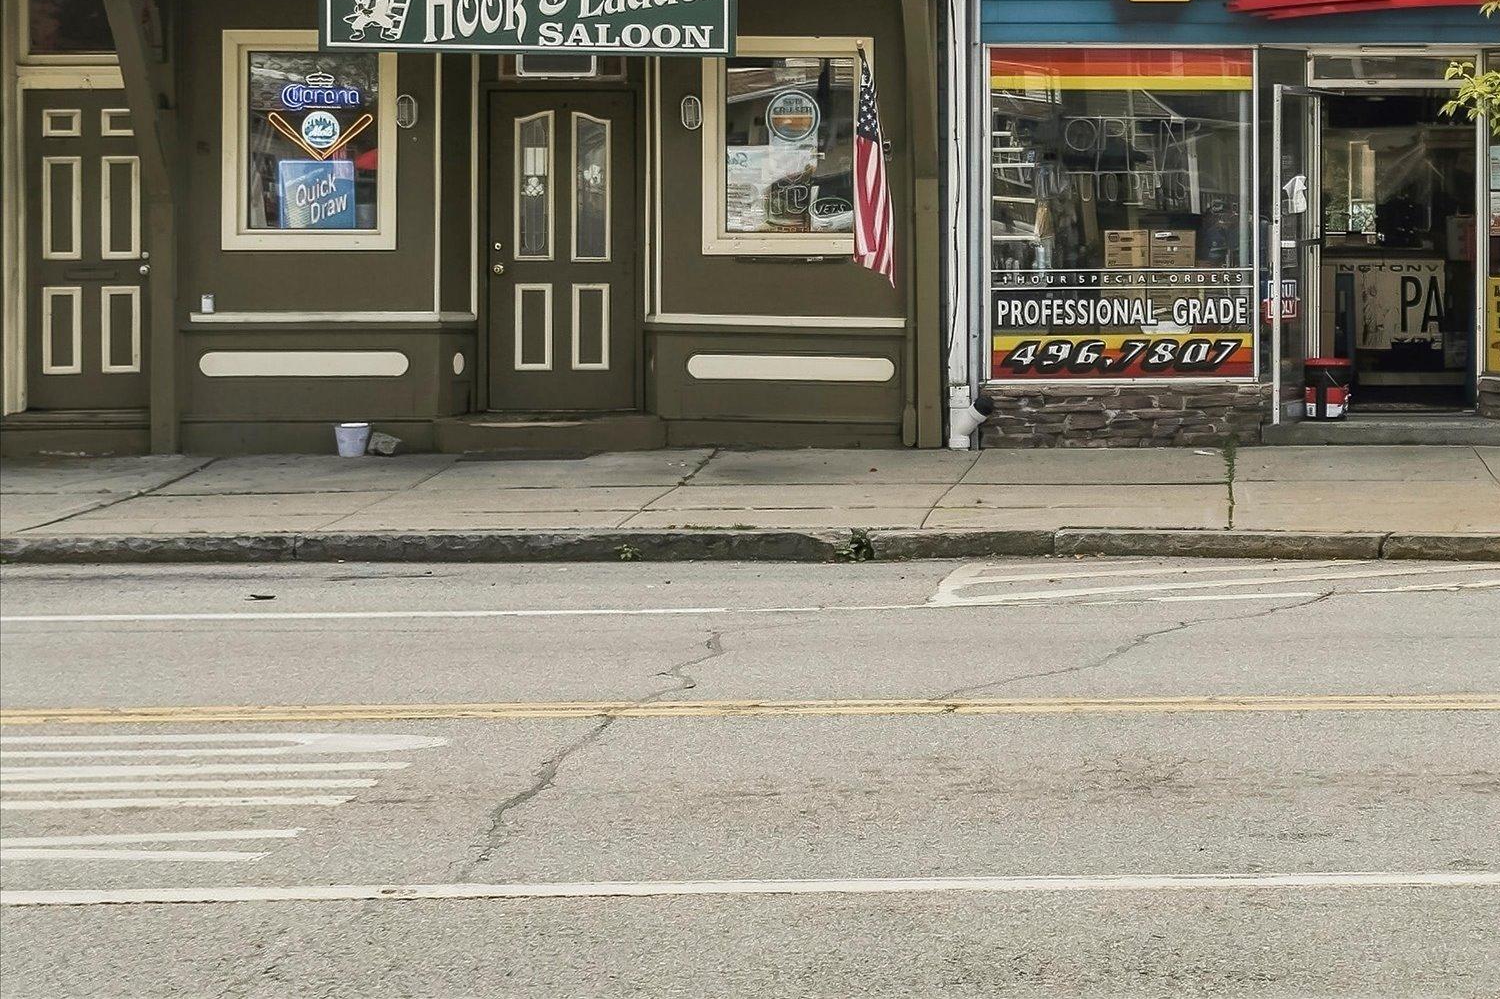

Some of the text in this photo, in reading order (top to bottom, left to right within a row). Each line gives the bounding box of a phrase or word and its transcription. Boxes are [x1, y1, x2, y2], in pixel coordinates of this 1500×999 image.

[538, 23, 713, 48] SALOON
[282, 83, 360, 111] Corona
[296, 173, 337, 207] Quick
[311, 193, 347, 224] Draw
[1002, 273, 1243, 284] 1 HOUR SPECIAL ORDERS
[997, 298, 1248, 326] PROFESSIONAL GRADE
